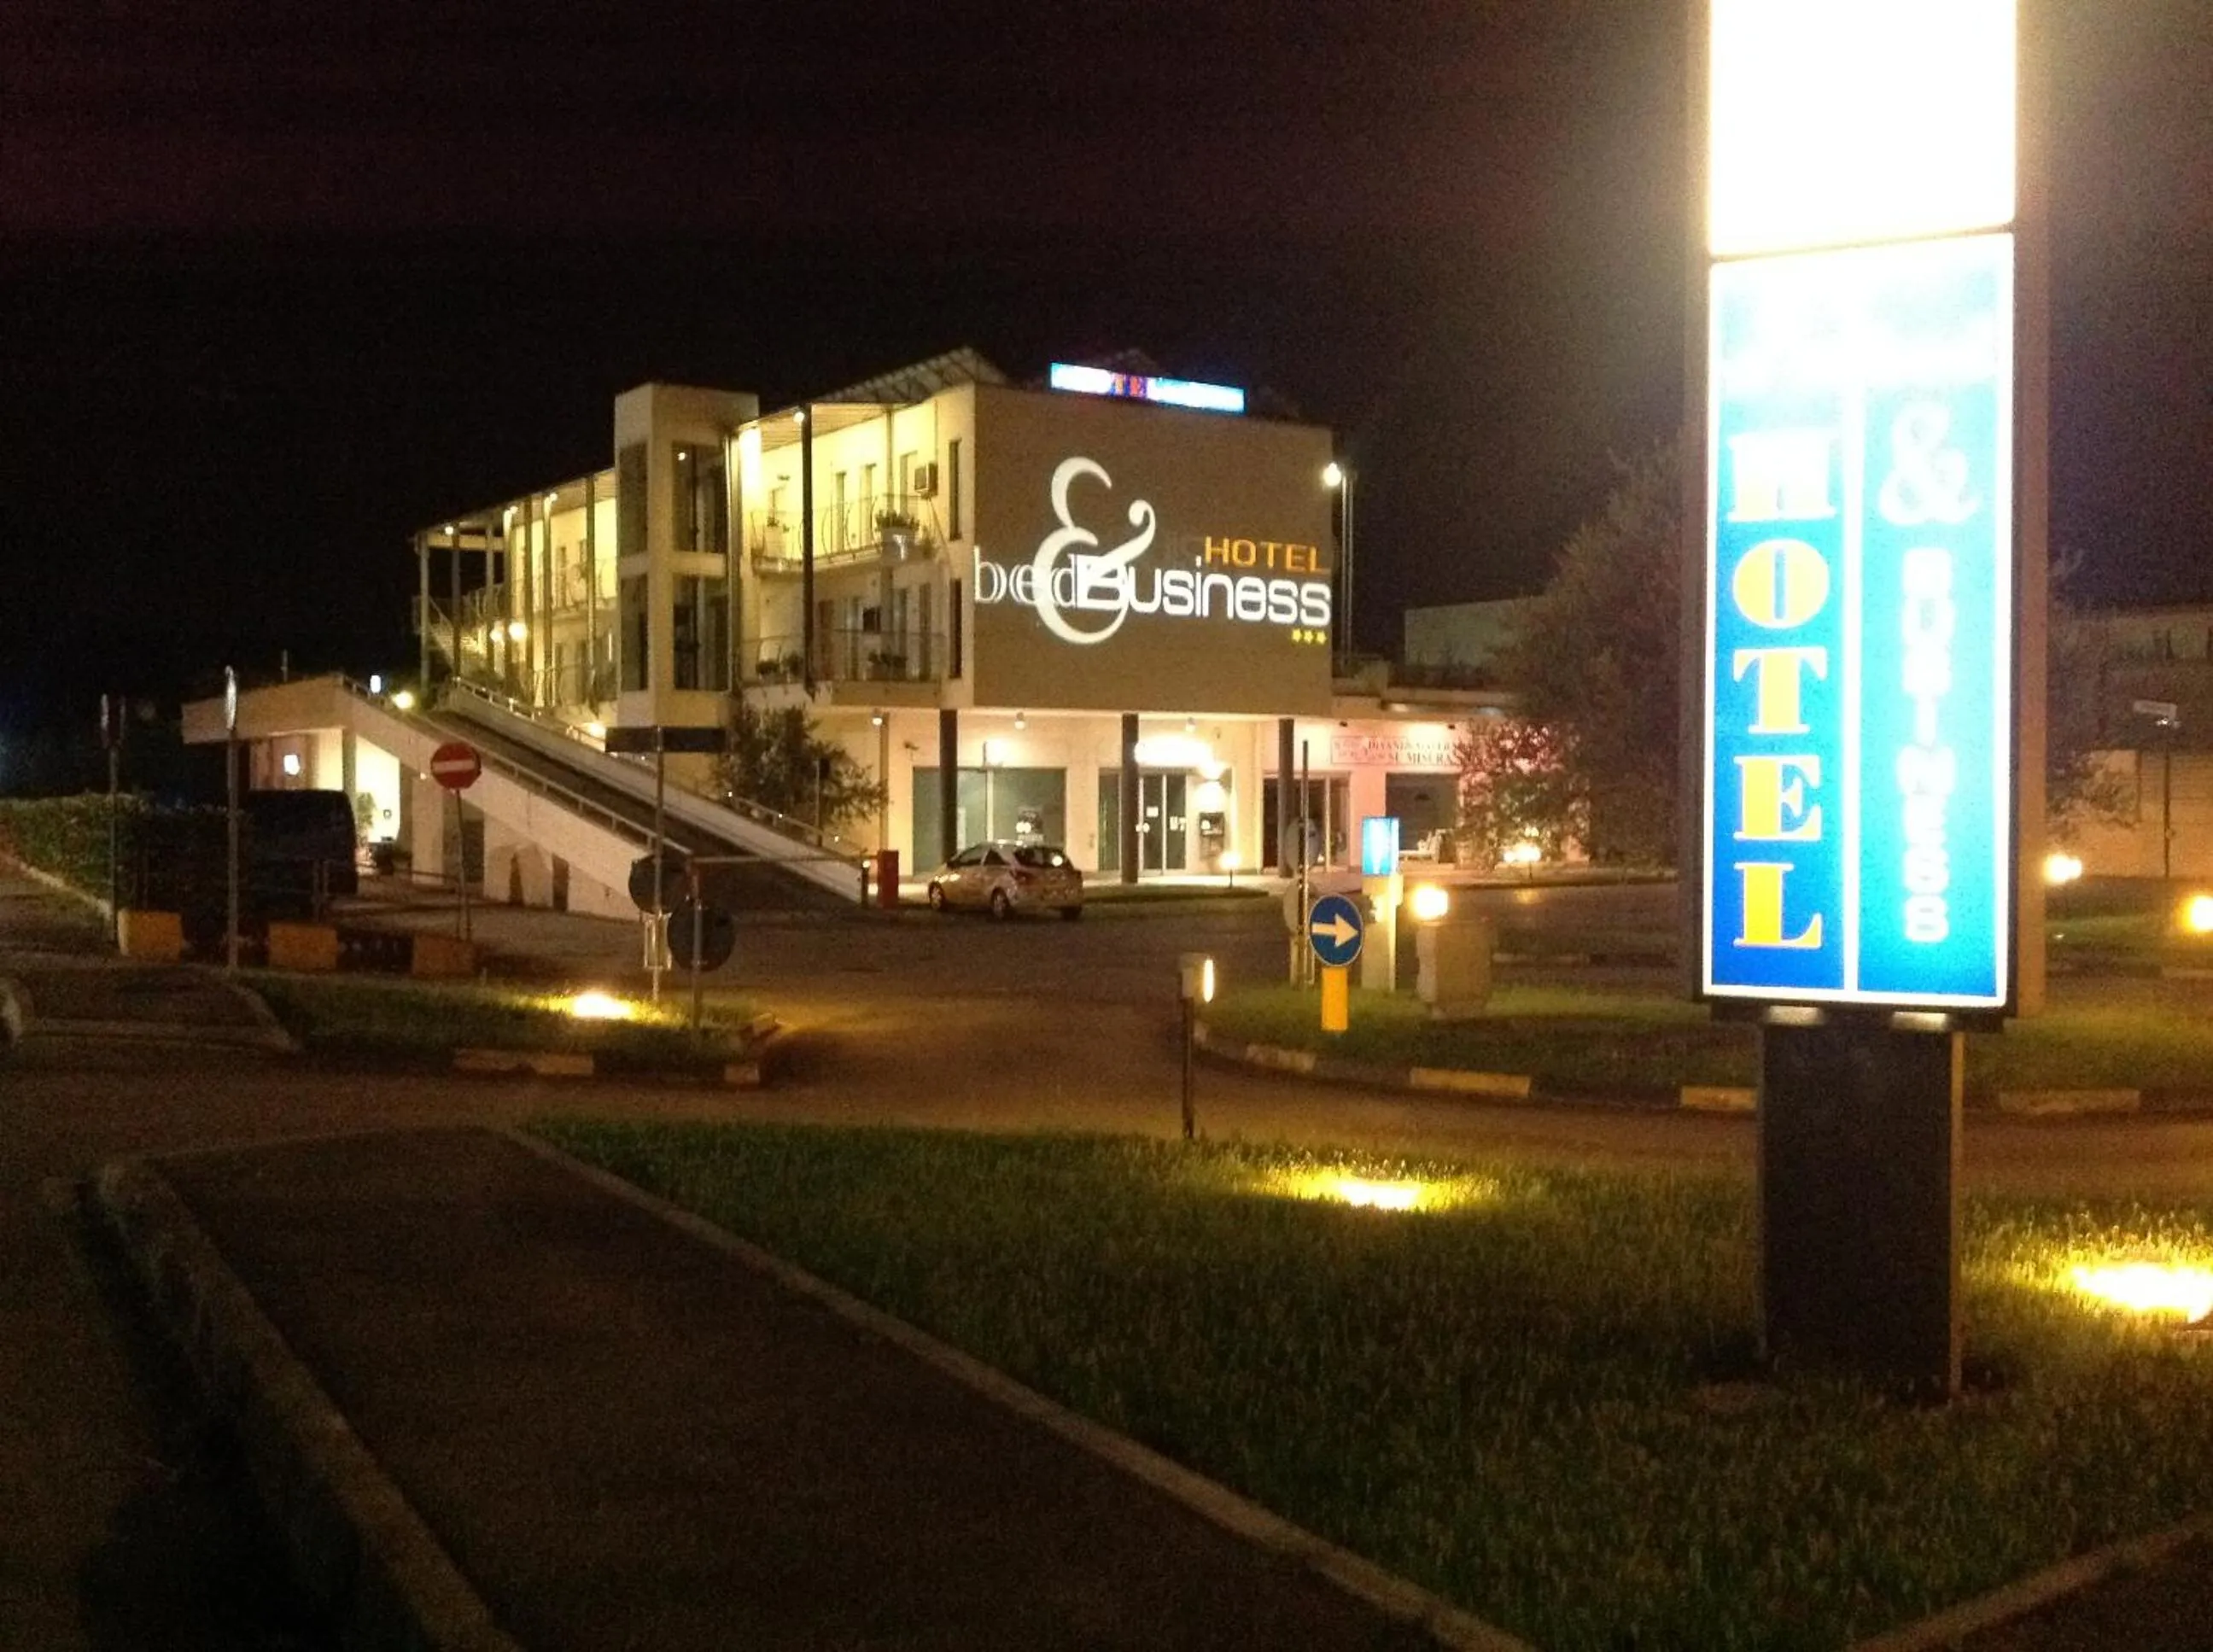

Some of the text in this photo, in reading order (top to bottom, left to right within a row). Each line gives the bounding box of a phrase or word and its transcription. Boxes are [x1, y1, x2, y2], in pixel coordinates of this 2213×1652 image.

[1878, 400, 1981, 526] &
[1205, 535, 1331, 573] HOTEL
[1727, 432, 1836, 949] HOTEL
